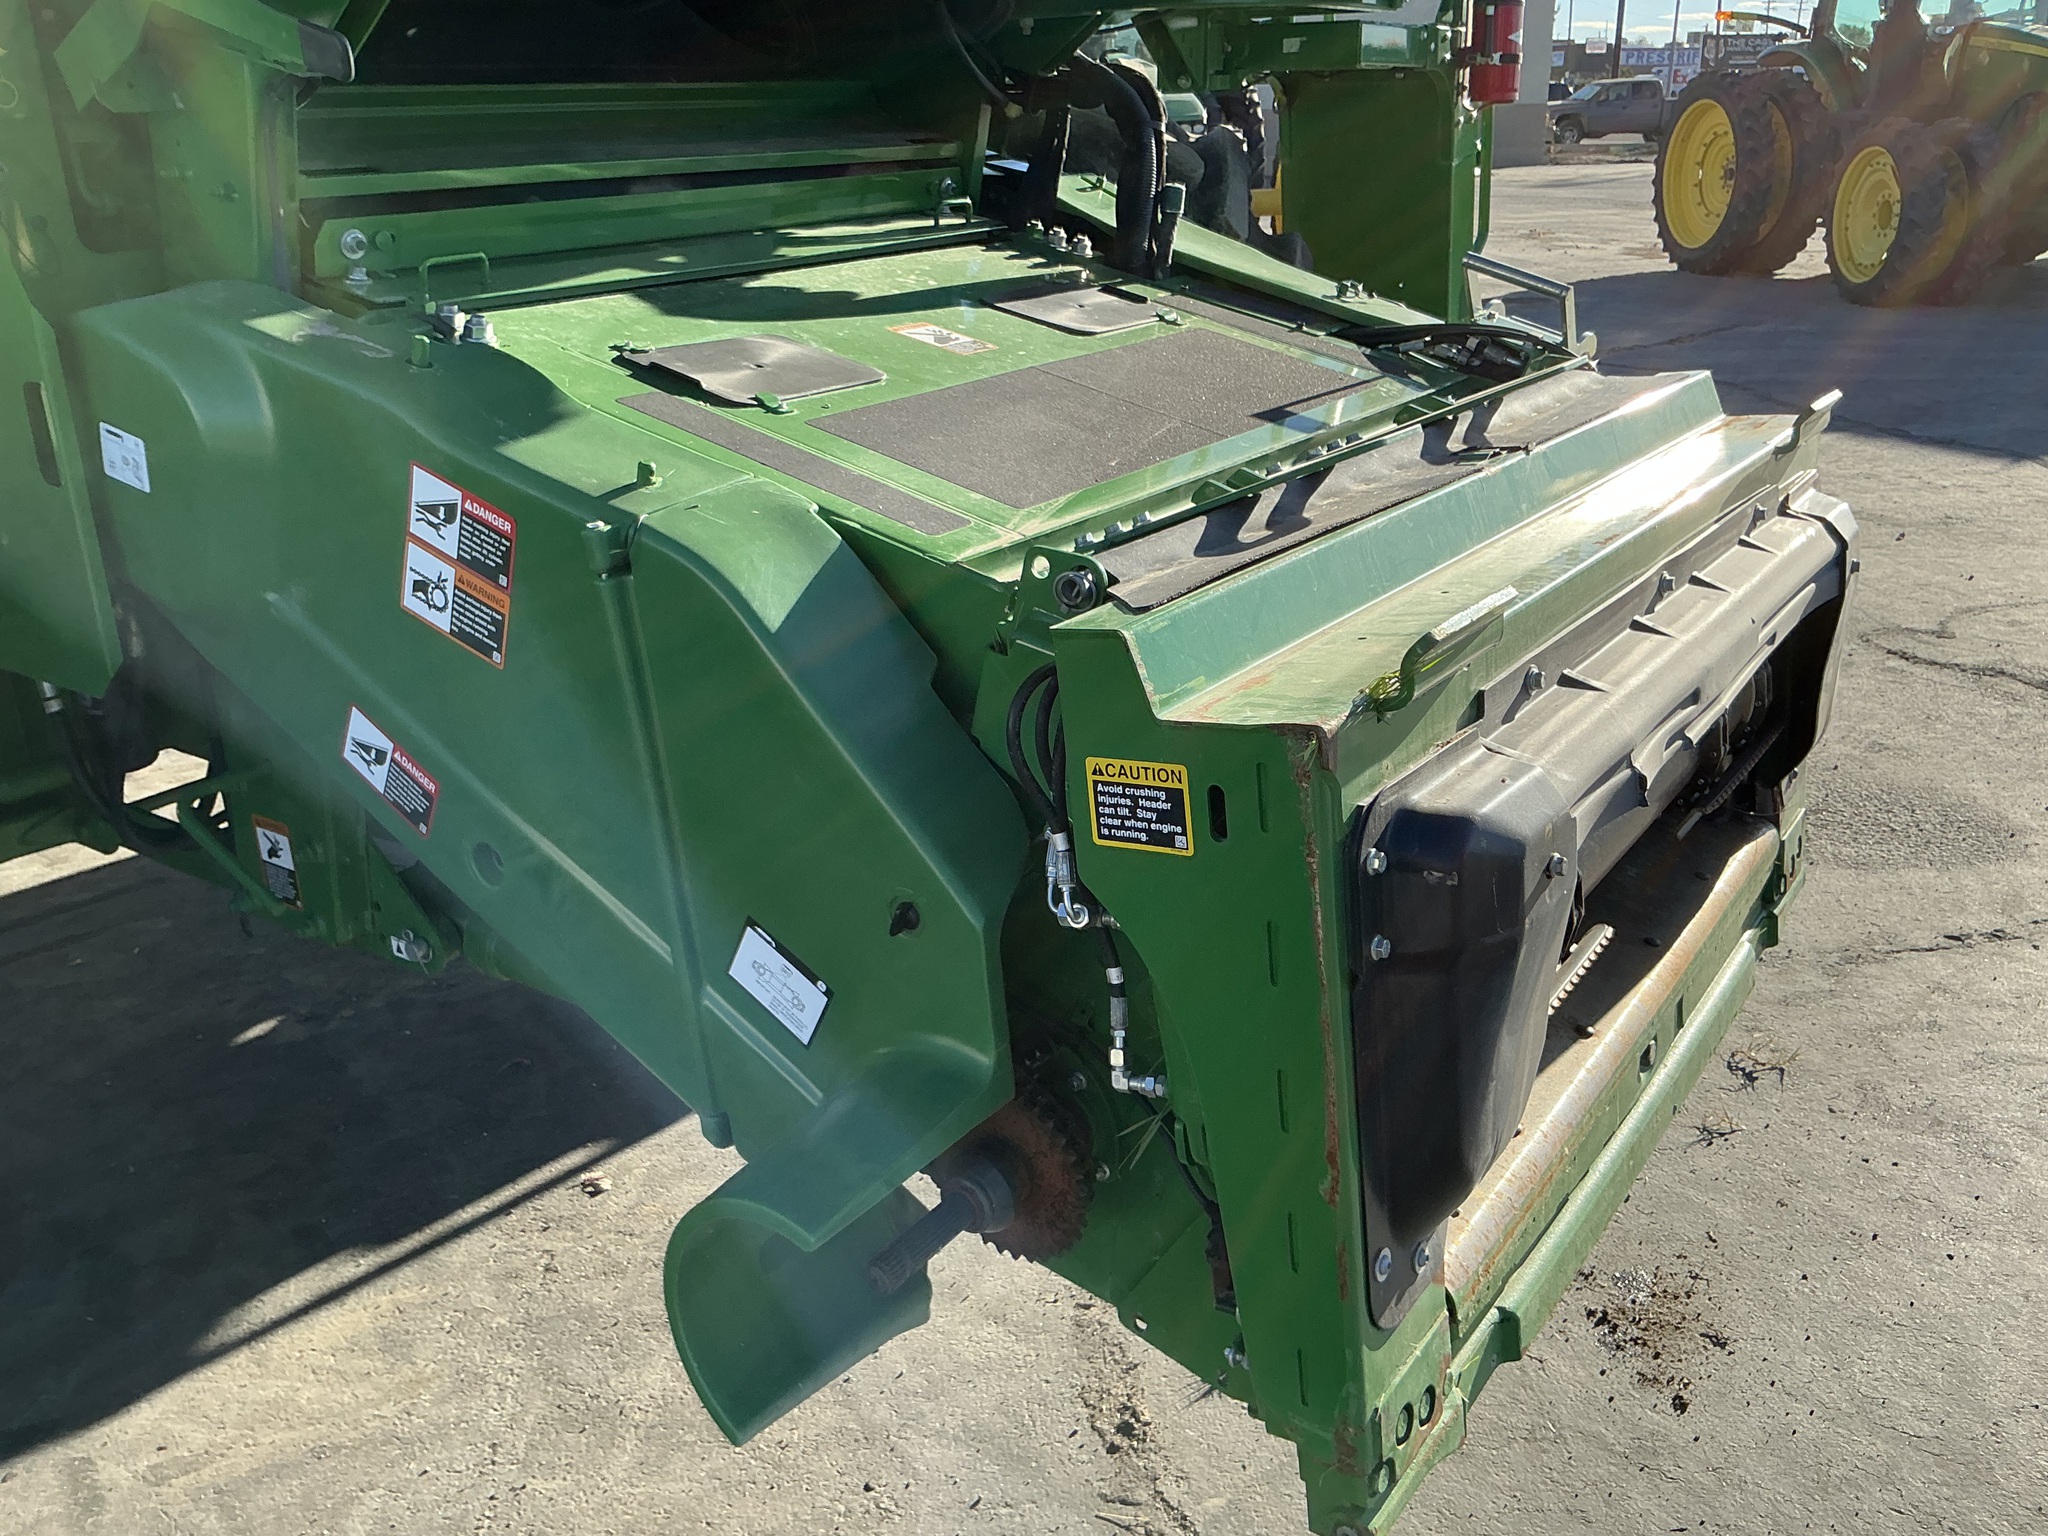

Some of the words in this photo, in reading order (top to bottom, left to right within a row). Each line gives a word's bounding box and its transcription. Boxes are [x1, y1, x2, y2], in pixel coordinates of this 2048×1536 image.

[472, 502, 511, 534] DANGER
[466, 579, 505, 609] WARNING
[401, 756, 436, 794] DANGER
[1105, 763, 1183, 785] CAUTION
[1097, 783, 1123, 794] Avoid
[1125, 786, 1166, 800] crushing
[1097, 794, 1134, 806] injuries.
[1139, 798, 1172, 810] Header
[1099, 806, 1116, 815] can
[1117, 807, 1132, 817] tilt.
[1137, 809, 1157, 821] Stay
[1100, 816, 1122, 827] clear
[1124, 819, 1149, 830] when
[1151, 823, 1182, 834] engine
[1101, 826, 1110, 835] is
[1111, 829, 1149, 842] running.
